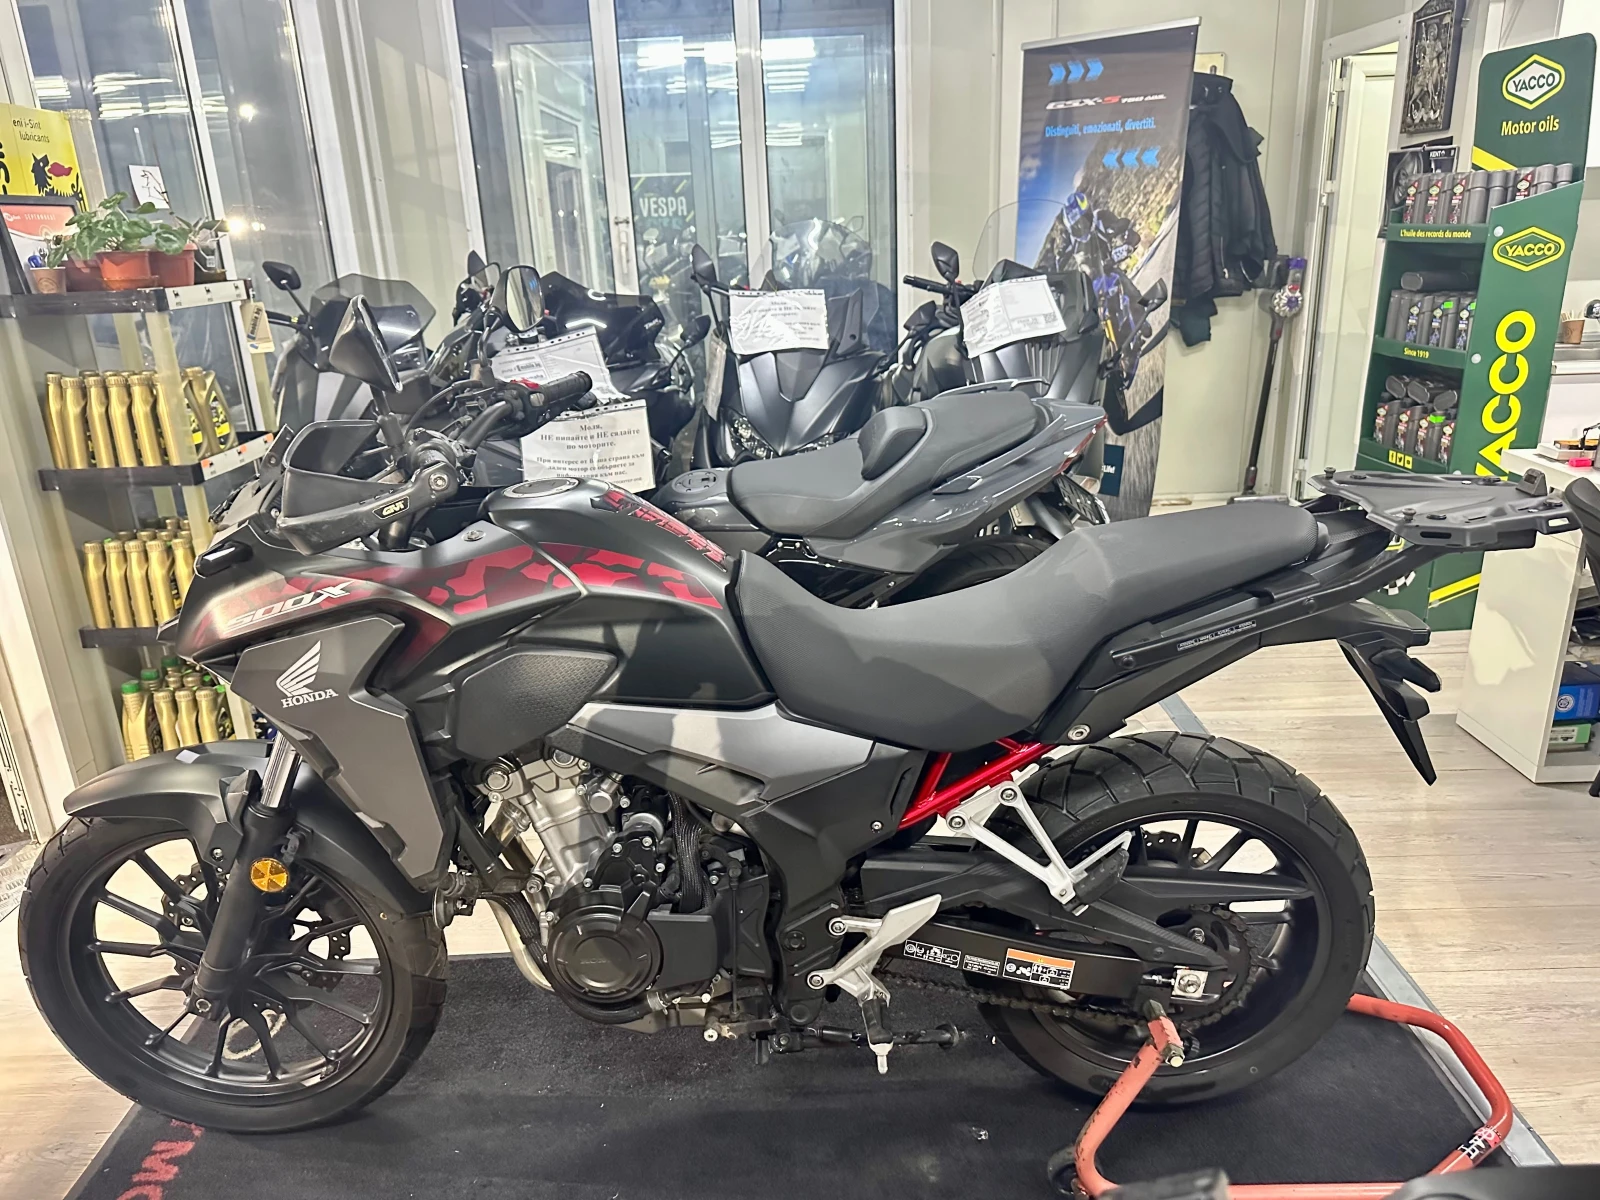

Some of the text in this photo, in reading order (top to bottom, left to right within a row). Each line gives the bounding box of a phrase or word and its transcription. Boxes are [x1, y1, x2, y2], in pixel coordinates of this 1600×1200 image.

[1512, 72, 1556, 93] YACCO
[12, 118, 23, 127] eni
[1045, 117, 1156, 138] Distinguiti, emozionati, divertiti.
[1501, 115, 1560, 136] Motor oils
[19, 131, 50, 143] lubricants
[638, 196, 688, 218] VESPA
[1400, 229, 1472, 238] L'huile des records du monde
[1505, 242, 1555, 257] YACCO
[1403, 347, 1429, 359] Since 1919
[596, 430, 609, 439] НЕ
[382, 500, 405, 516] GIVI
[225, 579, 355, 628] 500X
[280, 688, 339, 709] HONDA
